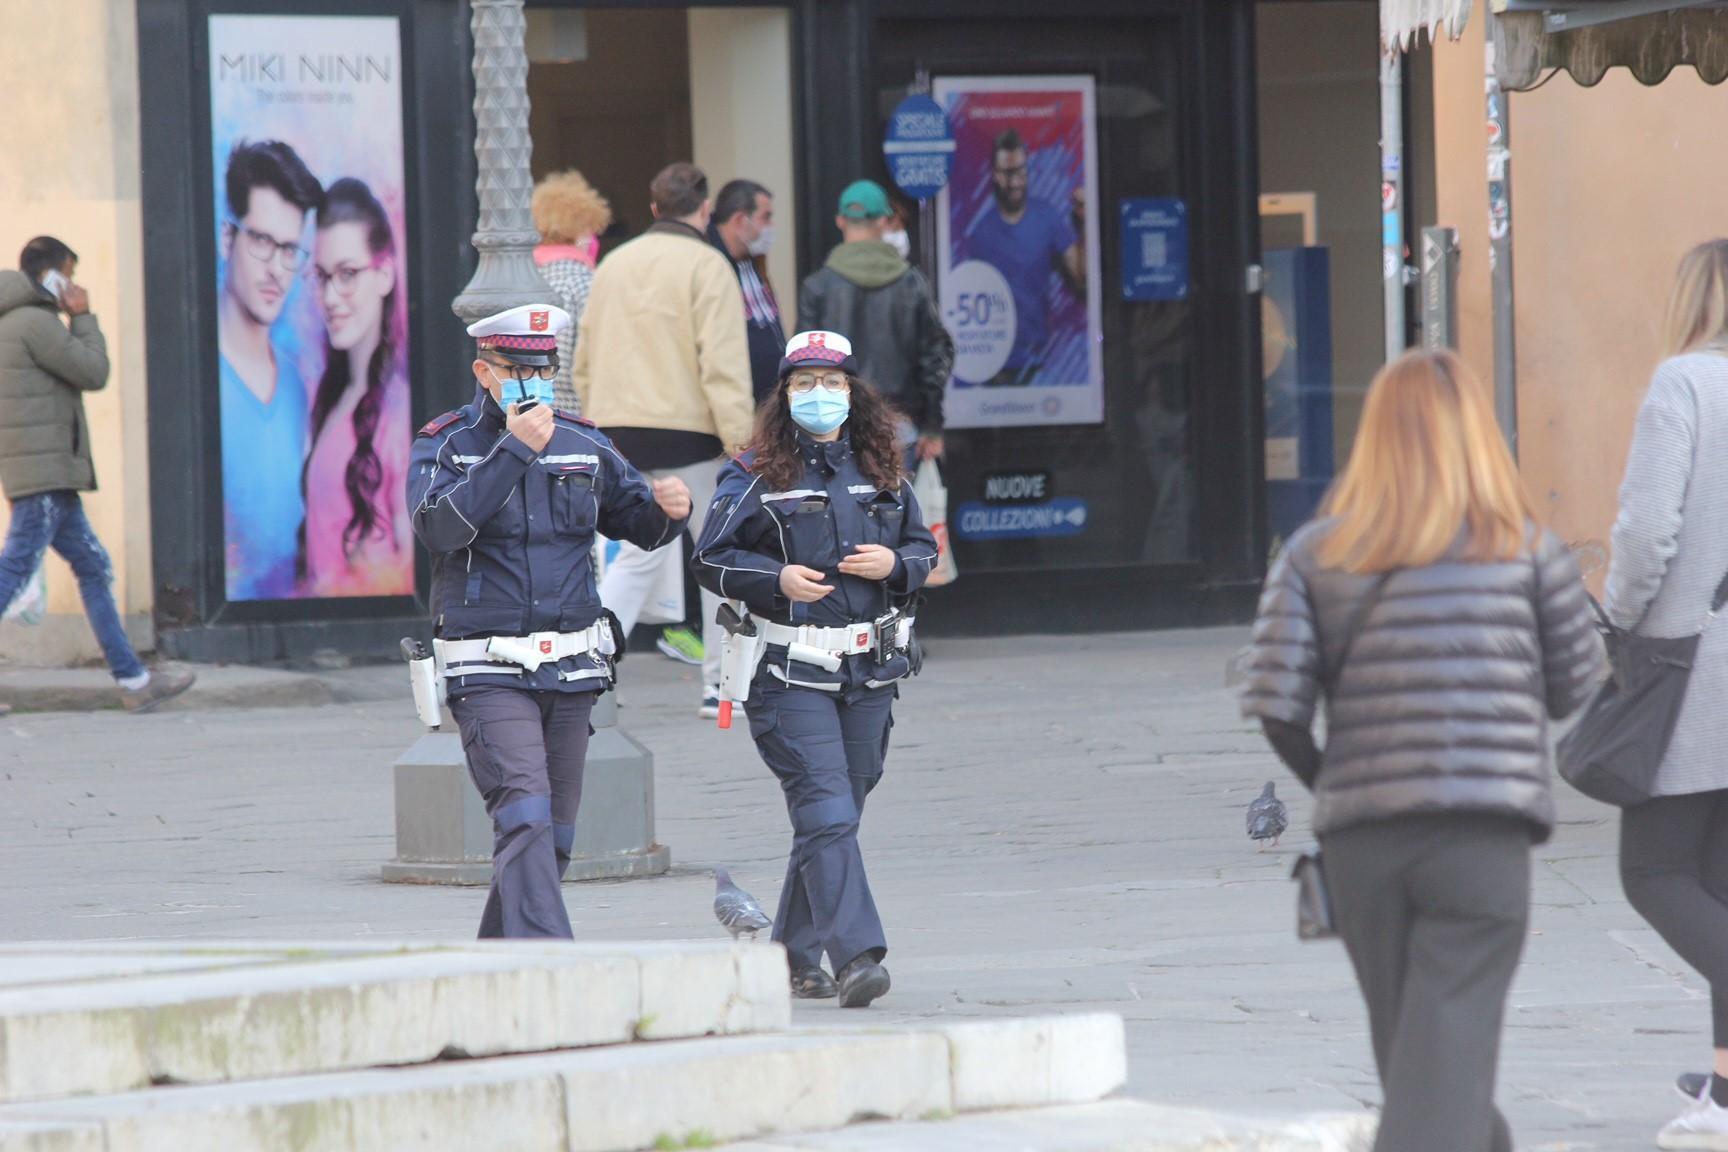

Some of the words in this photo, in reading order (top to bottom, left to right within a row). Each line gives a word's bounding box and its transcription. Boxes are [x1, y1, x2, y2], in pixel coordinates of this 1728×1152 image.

[220, 53, 286, 83] MIKI
[299, 54, 391, 84] NINN
[946, 291, 1009, 326] -50%
[985, 473, 1046, 500] NUOVE
[961, 507, 1053, 533] COLLEZIONI
